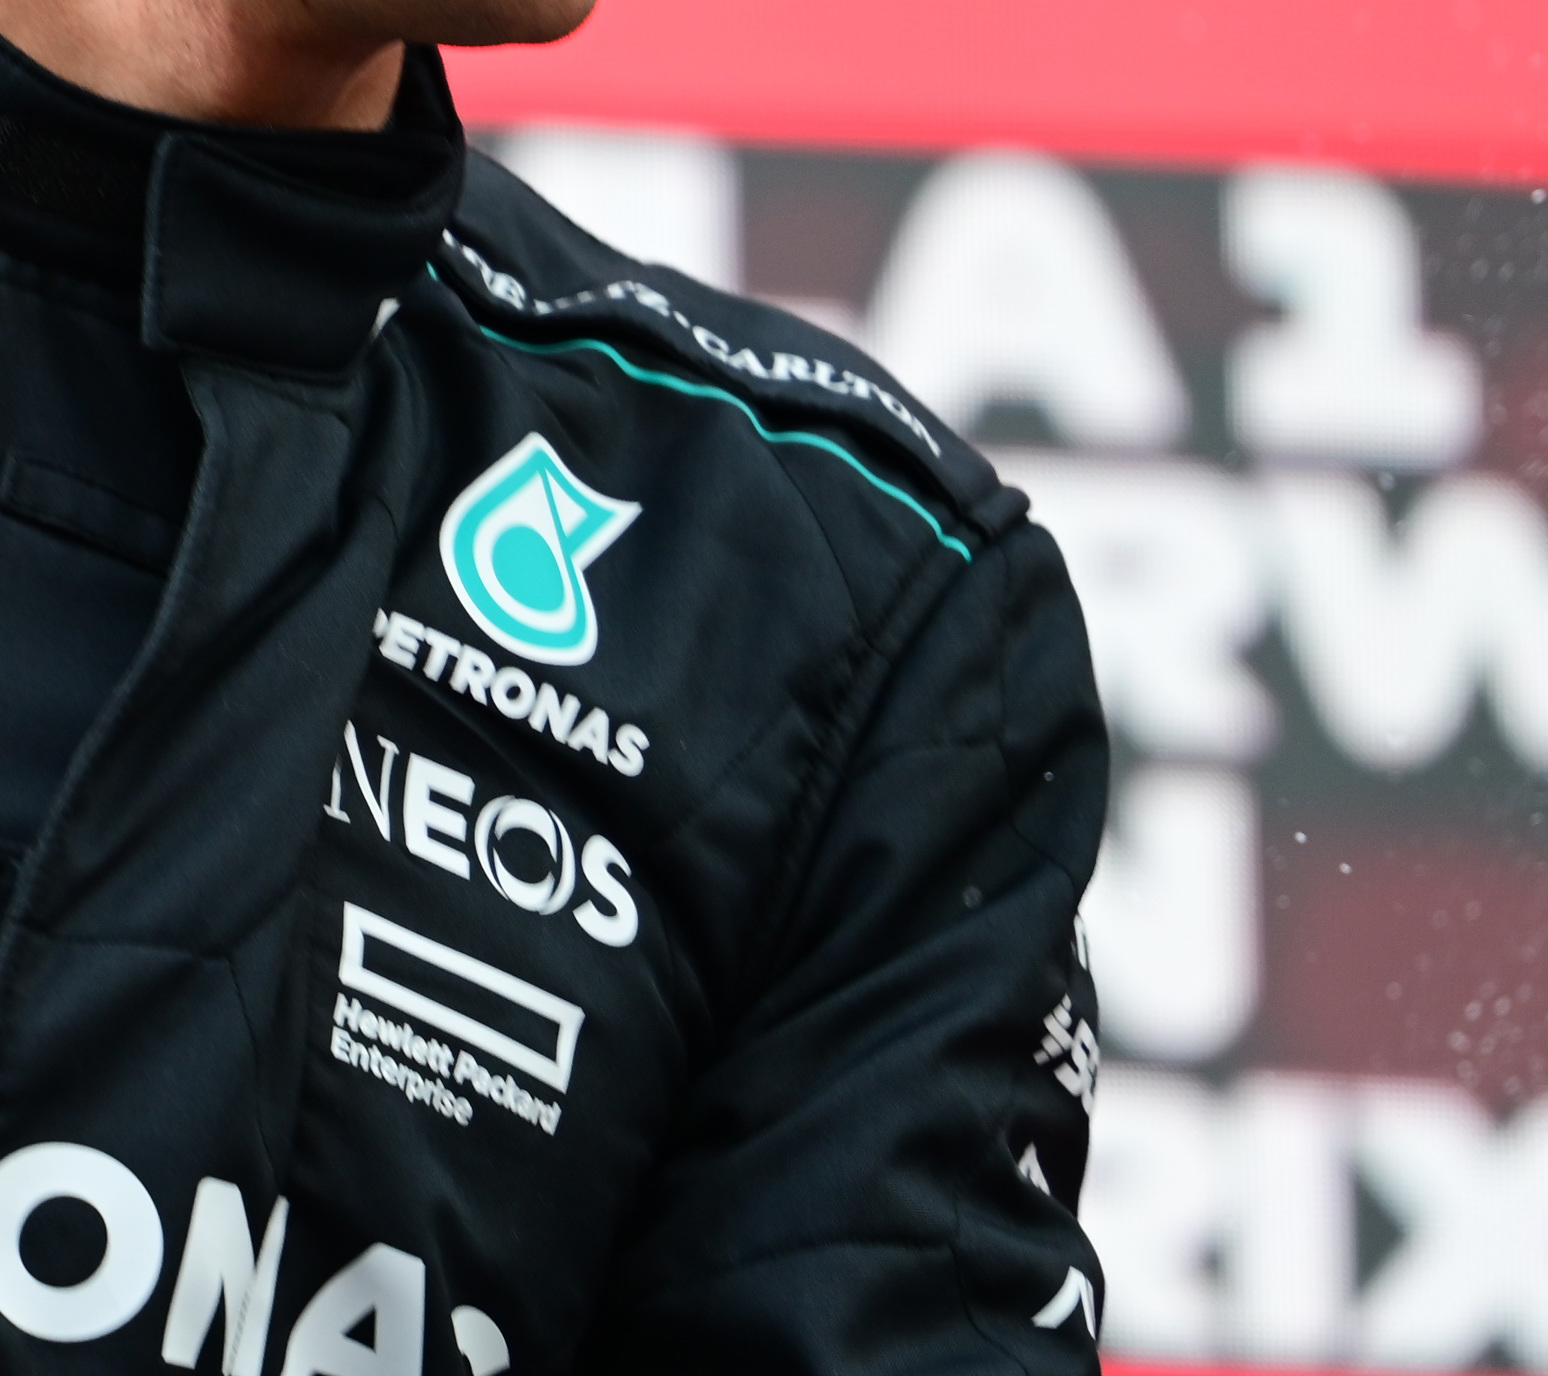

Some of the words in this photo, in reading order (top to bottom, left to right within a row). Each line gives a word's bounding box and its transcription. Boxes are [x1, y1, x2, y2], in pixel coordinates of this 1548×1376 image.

[324, 719, 640, 948] NEOS
[331, 1025, 474, 1127] Enterprise
[333, 992, 455, 1079] Hewlett
[454, 1049, 563, 1137] Packard
